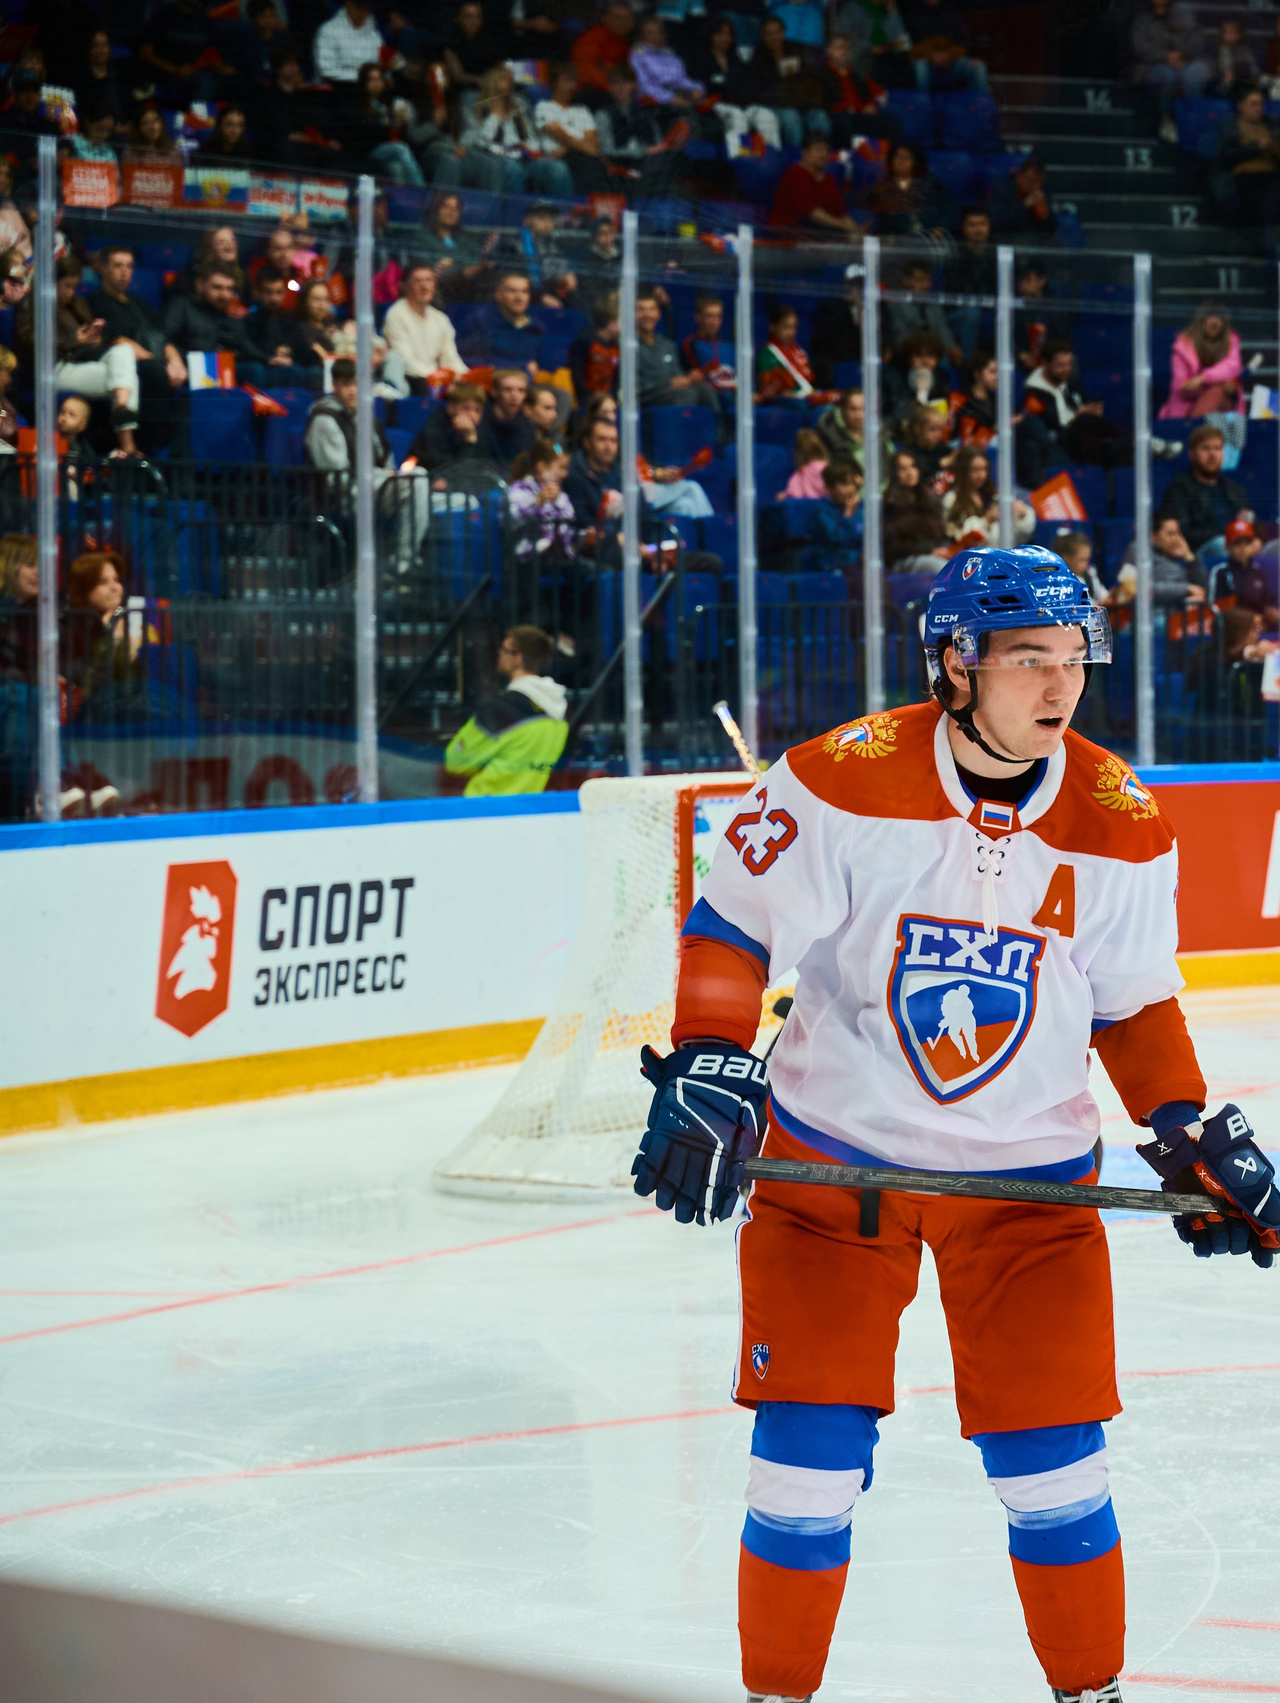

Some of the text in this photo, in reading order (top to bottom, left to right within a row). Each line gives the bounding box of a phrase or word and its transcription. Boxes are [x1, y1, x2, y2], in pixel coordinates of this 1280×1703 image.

[1124, 149, 1151, 171] 13
[1171, 205, 1197, 228] 12
[1218, 268, 1239, 291] 11
[1036, 587, 1073, 597] CCM
[934, 614, 959, 624] CCM
[724, 785, 799, 877] 23
[259, 877, 415, 951] СПОРТ
[905, 923, 1036, 982] СХЛ
[254, 954, 406, 1006] ЭКСПРЕСС
